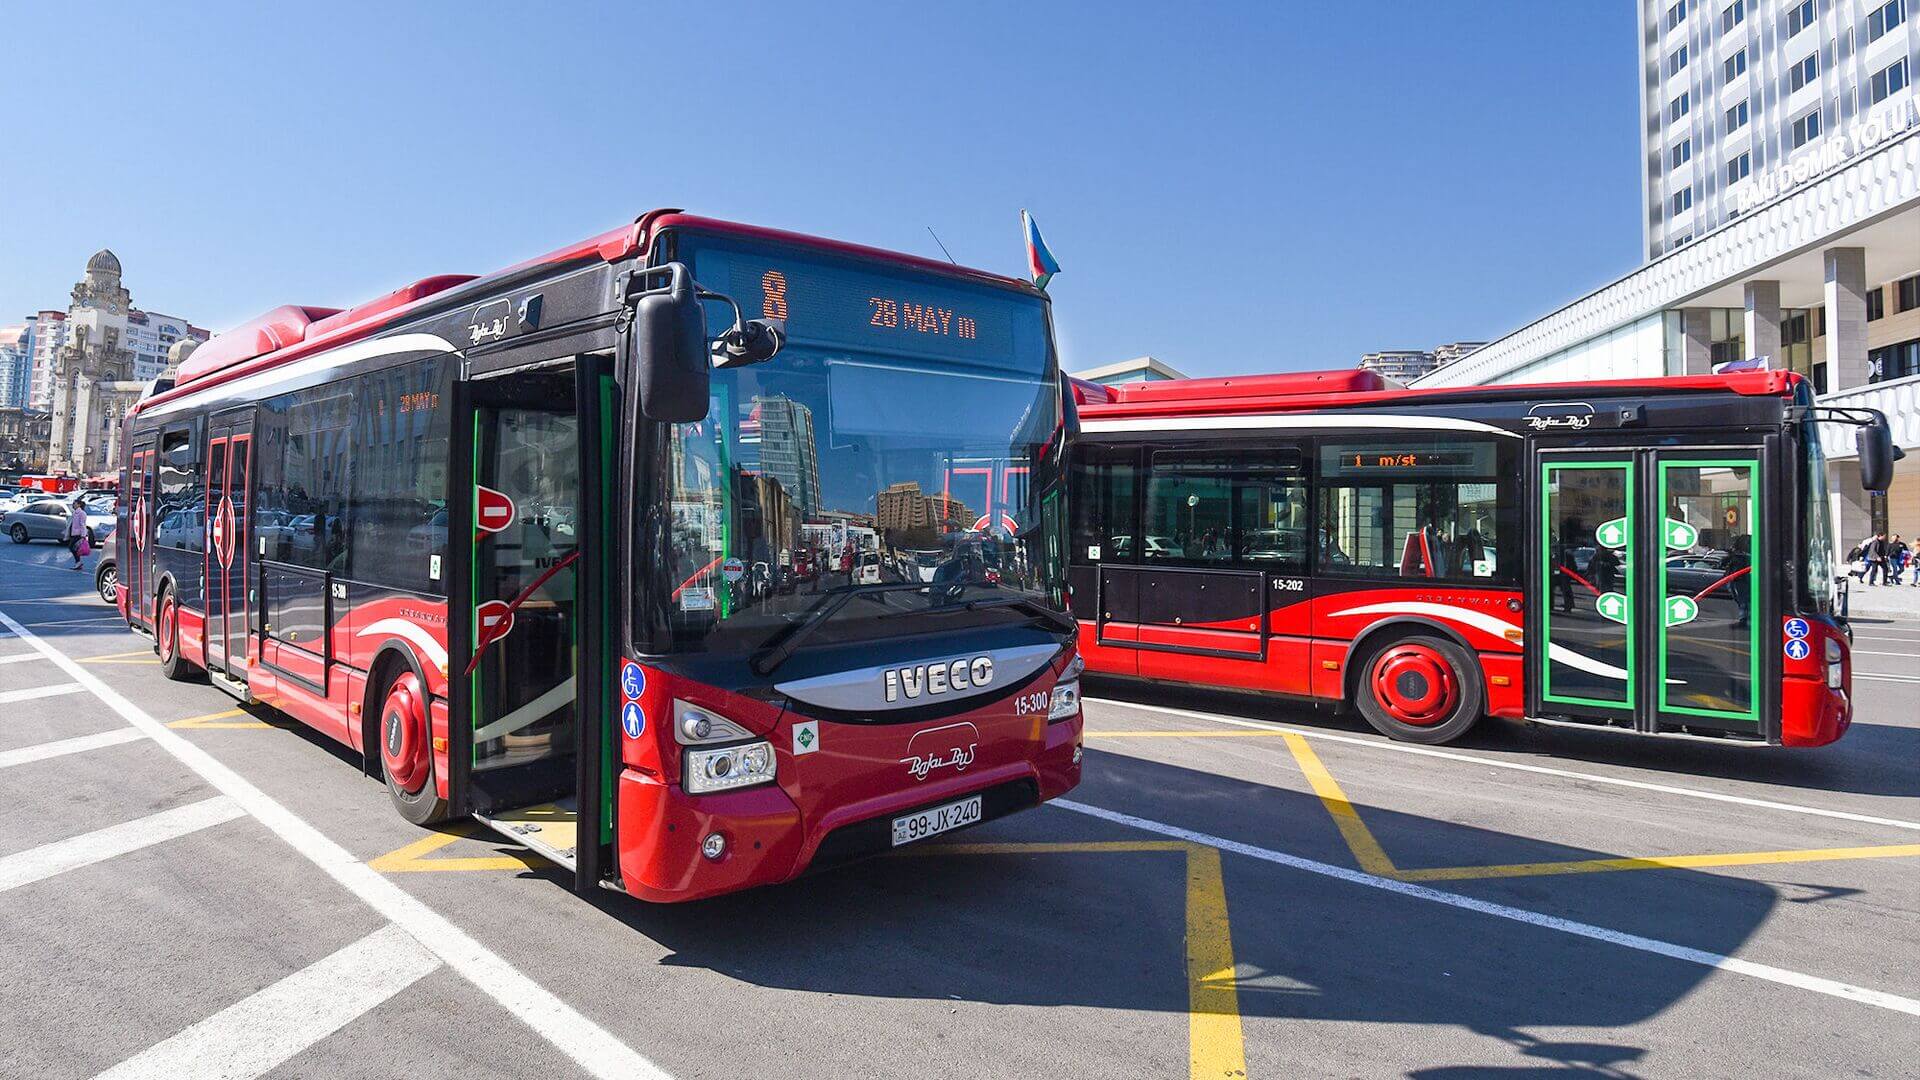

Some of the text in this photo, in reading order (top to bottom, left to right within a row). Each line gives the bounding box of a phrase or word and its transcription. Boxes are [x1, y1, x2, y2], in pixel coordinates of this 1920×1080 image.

[1849, 102, 1908, 155] YOLU
[762, 270, 976, 339] 8 28 MAY m
[411, 391, 430, 411] MAY
[1522, 416, 1560, 429] Baku
[1354, 454, 1417, 467] 1 m/st
[1272, 579, 1304, 591] 15-202
[884, 656, 994, 702] IVECO
[1014, 691, 1048, 716] 15-300
[900, 752, 943, 781] Baku
[908, 800, 980, 839] 99-JX-240
